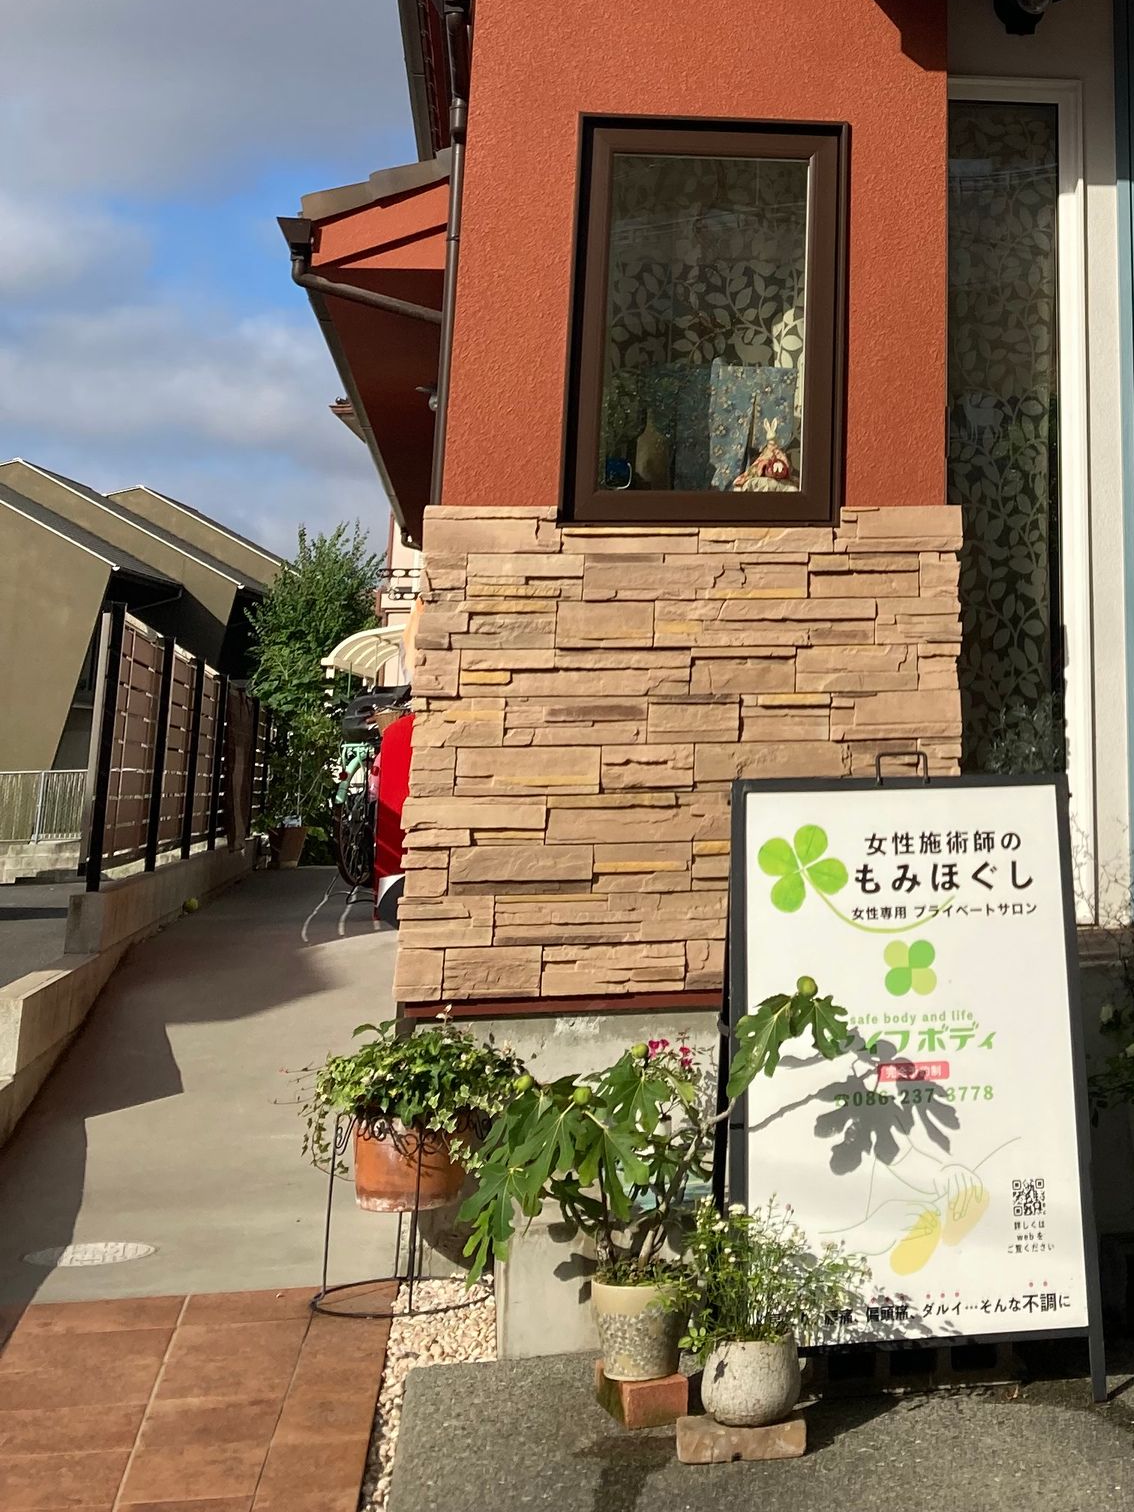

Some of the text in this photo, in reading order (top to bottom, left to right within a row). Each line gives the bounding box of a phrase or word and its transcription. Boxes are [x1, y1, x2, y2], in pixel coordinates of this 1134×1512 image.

[864, 829, 1022, 857] 女性施術師の
[854, 859, 1035, 894] もみほぐし
[851, 902, 1037, 921] 女性専用 プライベートサロン
[850, 1009, 974, 1026] safe body and life
[842, 1022, 998, 1056] イフボディ
[852, 1084, 994, 1108] 086-2373778
[1007, 1243, 1056, 1255] ご覧ください
